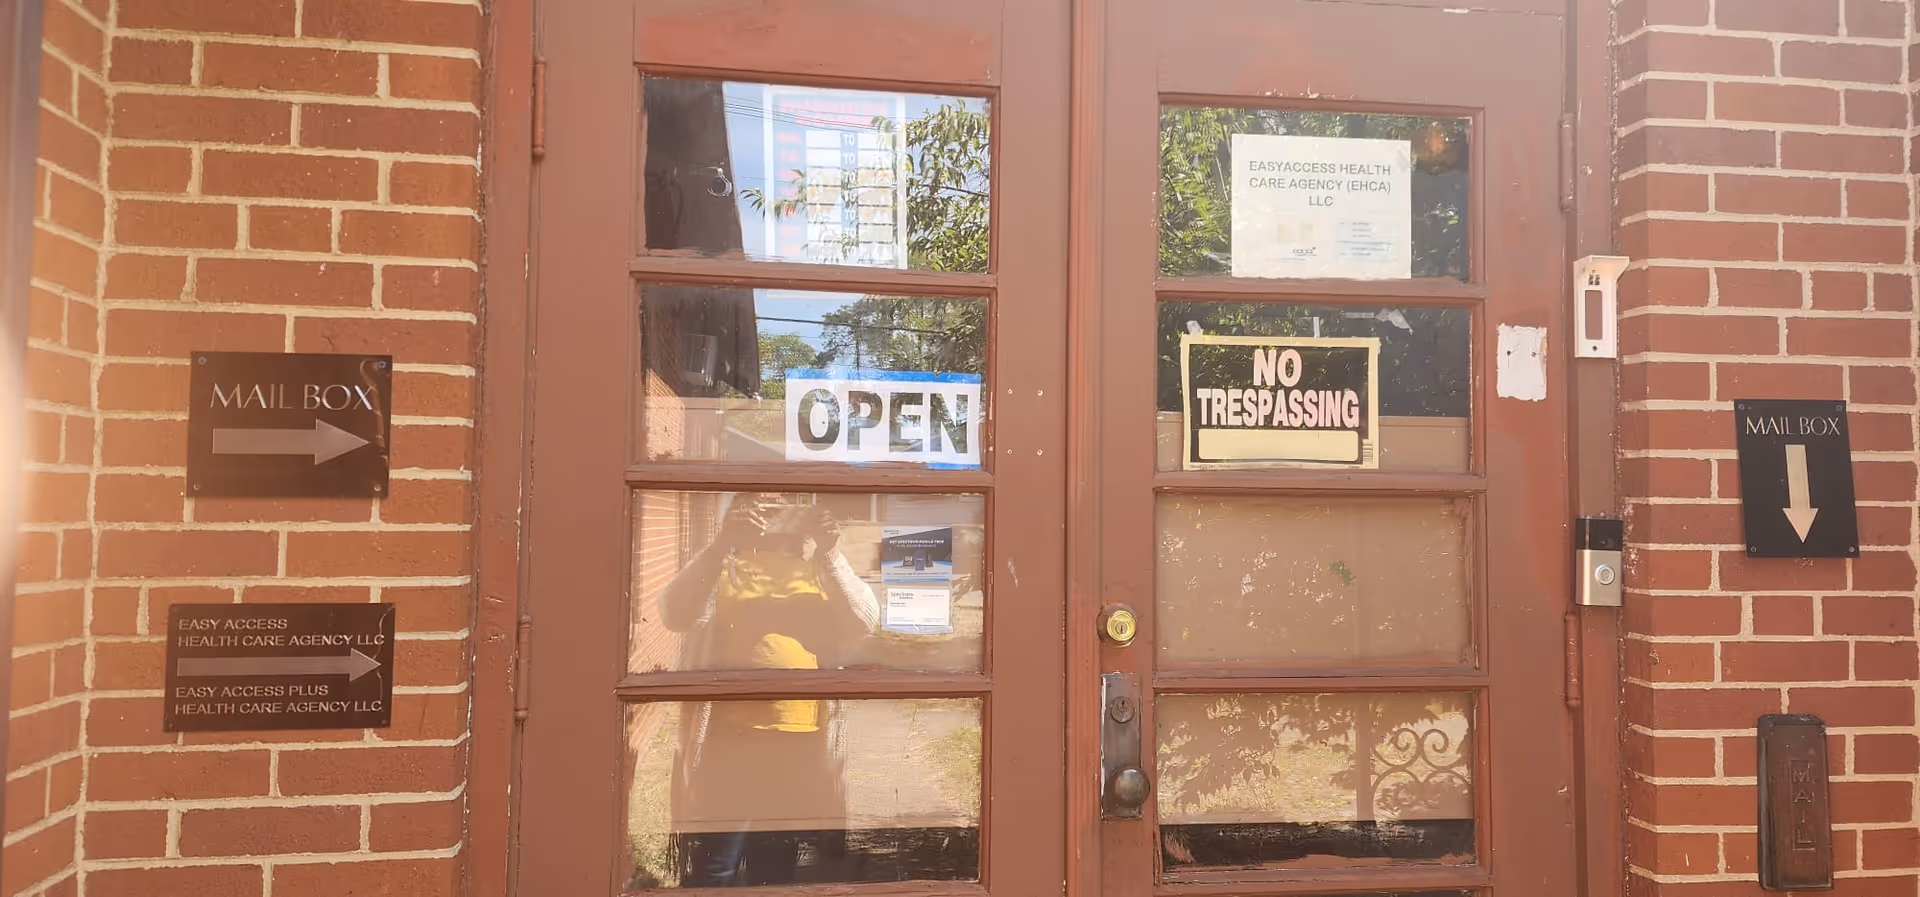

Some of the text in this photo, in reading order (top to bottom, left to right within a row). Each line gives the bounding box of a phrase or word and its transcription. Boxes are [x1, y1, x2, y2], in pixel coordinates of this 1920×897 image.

[844, 135, 855, 145] TO
[844, 154, 855, 164] TO
[1249, 161, 1391, 176] EASYACCESS HEALTH
[1249, 177, 1391, 194] CARE AGENCY (EHCA)
[1308, 196, 1334, 207] LLC
[1253, 348, 1303, 387] NO
[210, 383, 377, 410] MAIL BOX
[1196, 388, 1360, 428] TRESPASSING
[798, 388, 969, 454] OPEN
[1746, 416, 1841, 436] MAIL BOX
[178, 618, 288, 630] EASY ACCESS
[178, 634, 385, 647] HEALTH CARE AGENCY LLC
[176, 685, 329, 698] EASY ACCESS PLUS
[175, 703, 235, 715] HEALTH
[240, 702, 282, 714] CARE
[286, 701, 351, 713] AGENCY
[1792, 766, 1815, 846] MAIL
